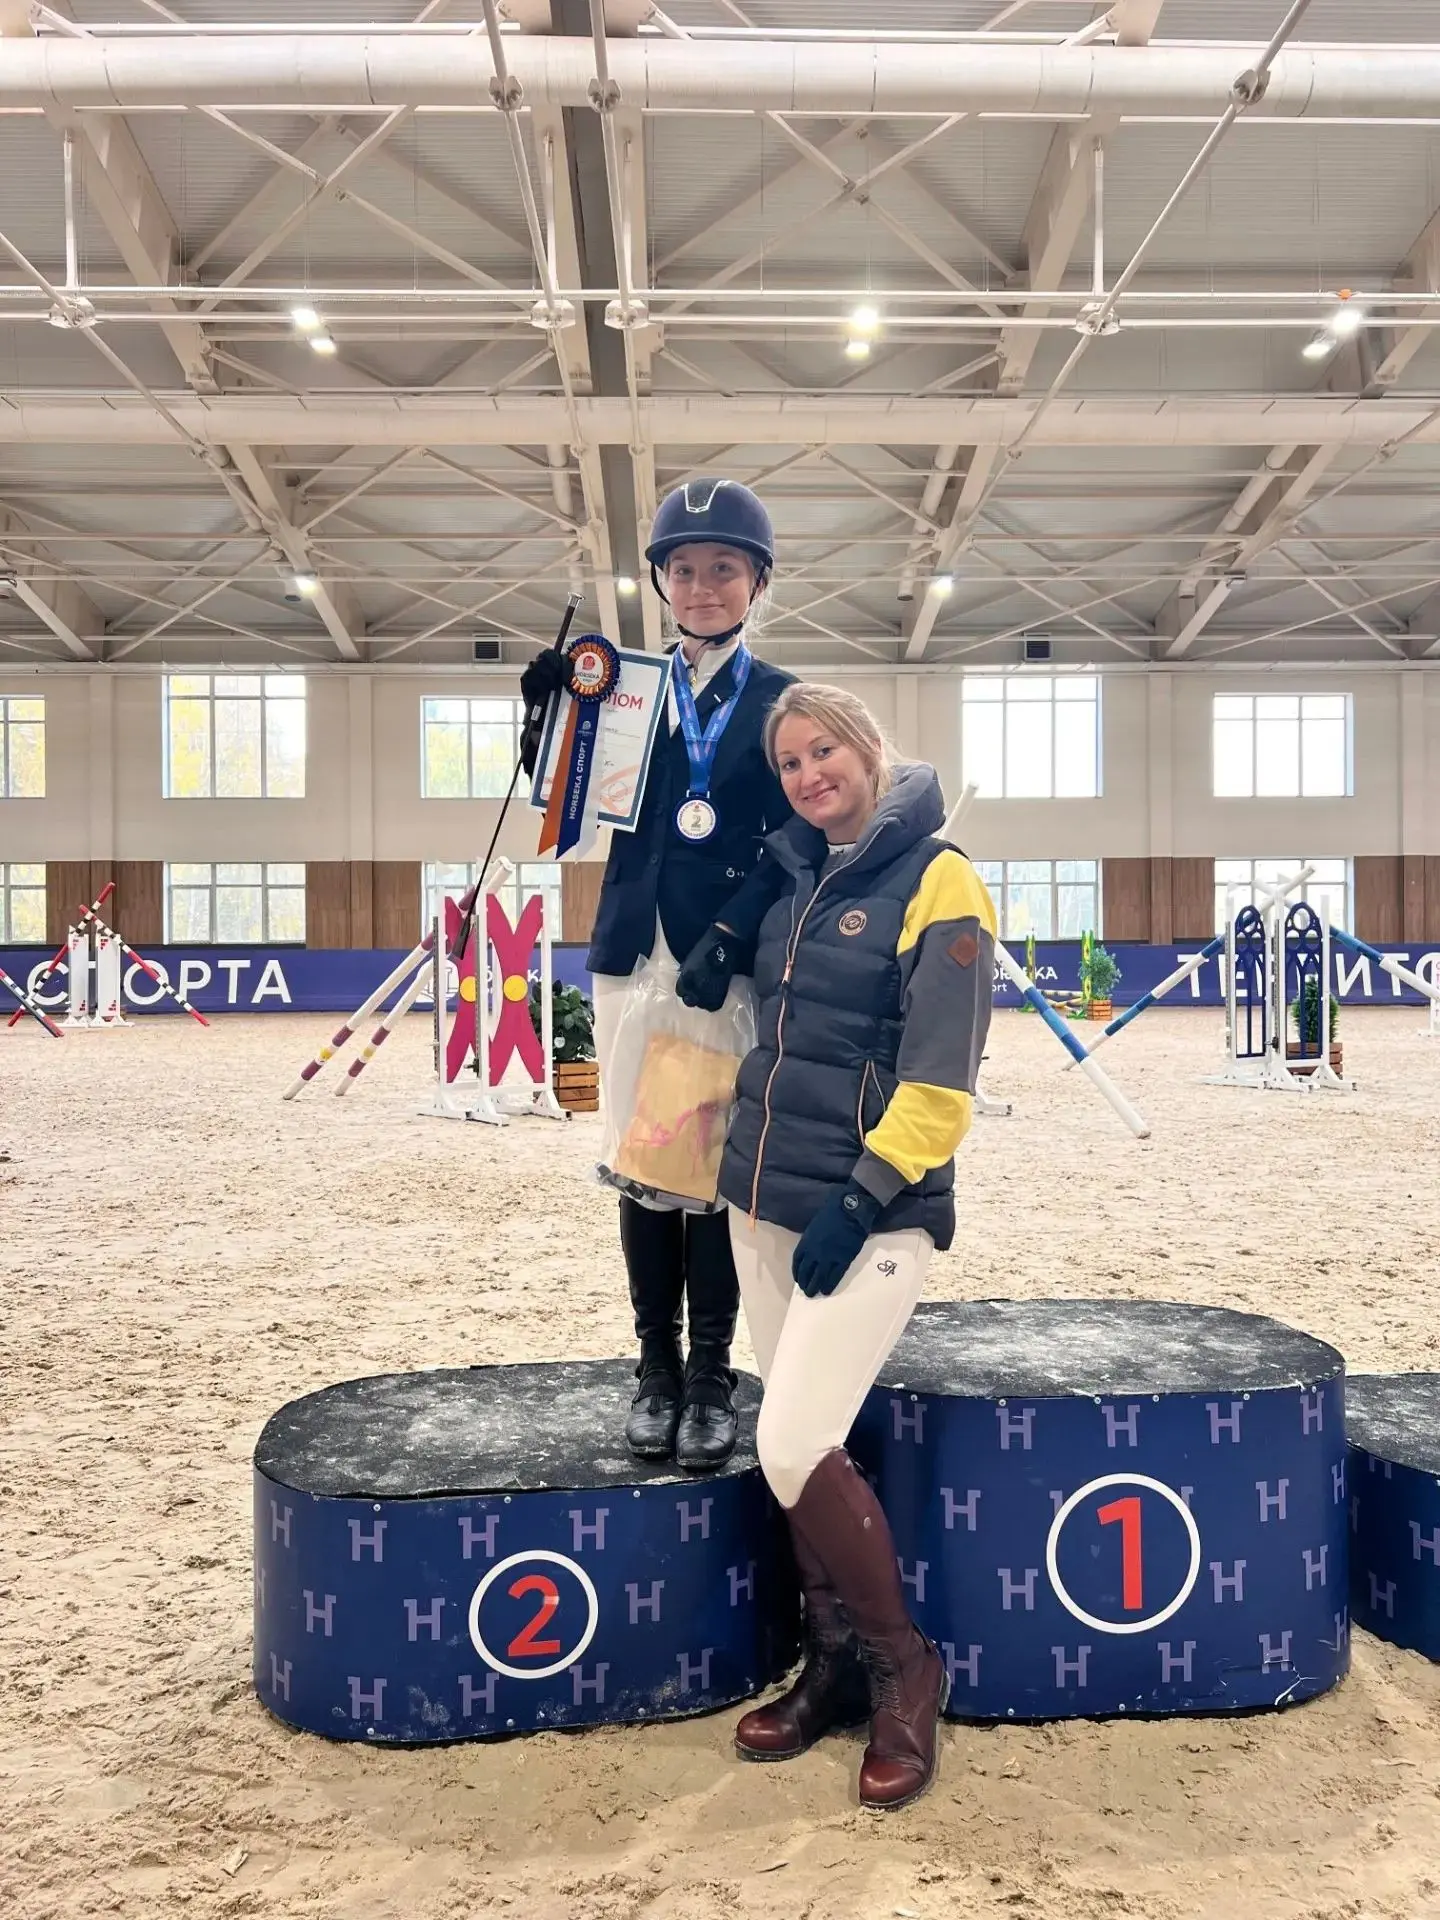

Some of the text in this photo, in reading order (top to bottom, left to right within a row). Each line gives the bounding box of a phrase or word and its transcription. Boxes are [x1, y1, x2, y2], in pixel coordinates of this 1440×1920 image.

[606, 692, 643, 710] ЛОМ
[576, 740, 588, 773] СПОРТ
[27, 959, 292, 1005] СОРТА
[1097, 1497, 1142, 1609] 1
[508, 1575, 560, 1657] 2
